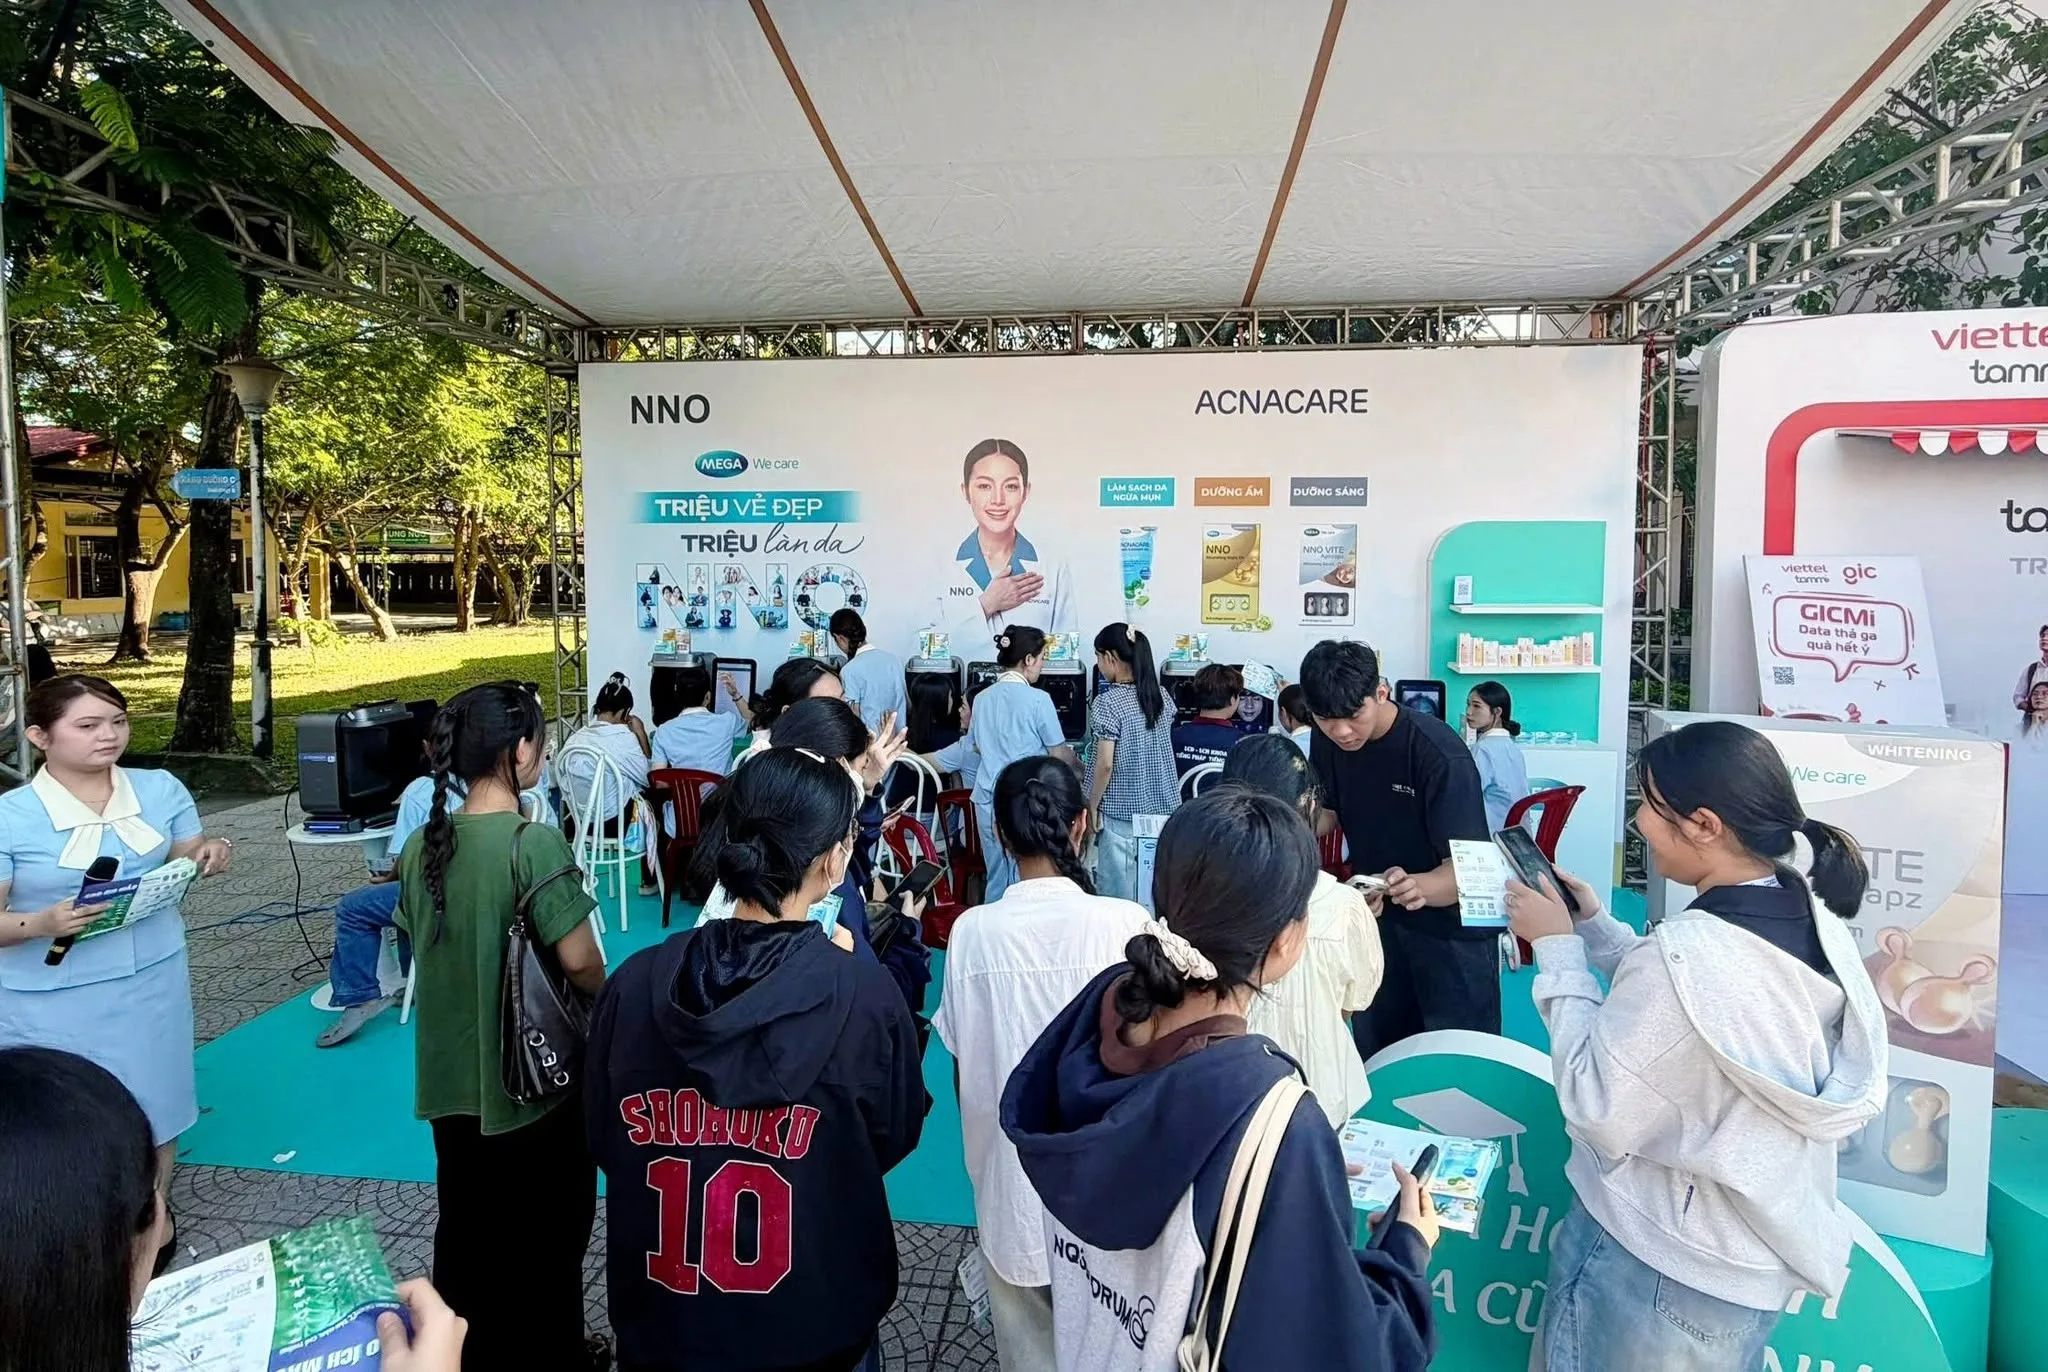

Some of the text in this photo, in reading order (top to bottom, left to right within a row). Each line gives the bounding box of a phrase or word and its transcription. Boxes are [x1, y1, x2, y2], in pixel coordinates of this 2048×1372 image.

[631, 394, 711, 424] NNO
[1195, 389, 1368, 414] ACNACARE
[701, 458, 799, 470] MEGA We care
[1154, 484, 1167, 492] DA
[1201, 485, 1243, 497] DƯỠNG
[1293, 485, 1365, 497] DƯỠNG SÁNG
[654, 493, 823, 521] TRIỆU VẺ ĐẸP
[681, 521, 865, 558] TRIỆU làn da
[1206, 545, 1231, 554] NNO
[1303, 546, 1345, 554] NNO VITE
[1781, 563, 1877, 585] viettel gic
[636, 563, 868, 630] NNO
[950, 587, 974, 596] NNO
[1800, 603, 1876, 627] GICMi
[1799, 624, 1831, 637] Data
[1860, 632, 1877, 642] ga
[1836, 640, 1858, 653] hết
[1868, 744, 1972, 761] WHITENING
[1823, 770, 1867, 786] care
[1860, 846, 1924, 884] TE
[646, 1155, 792, 1294] 10
